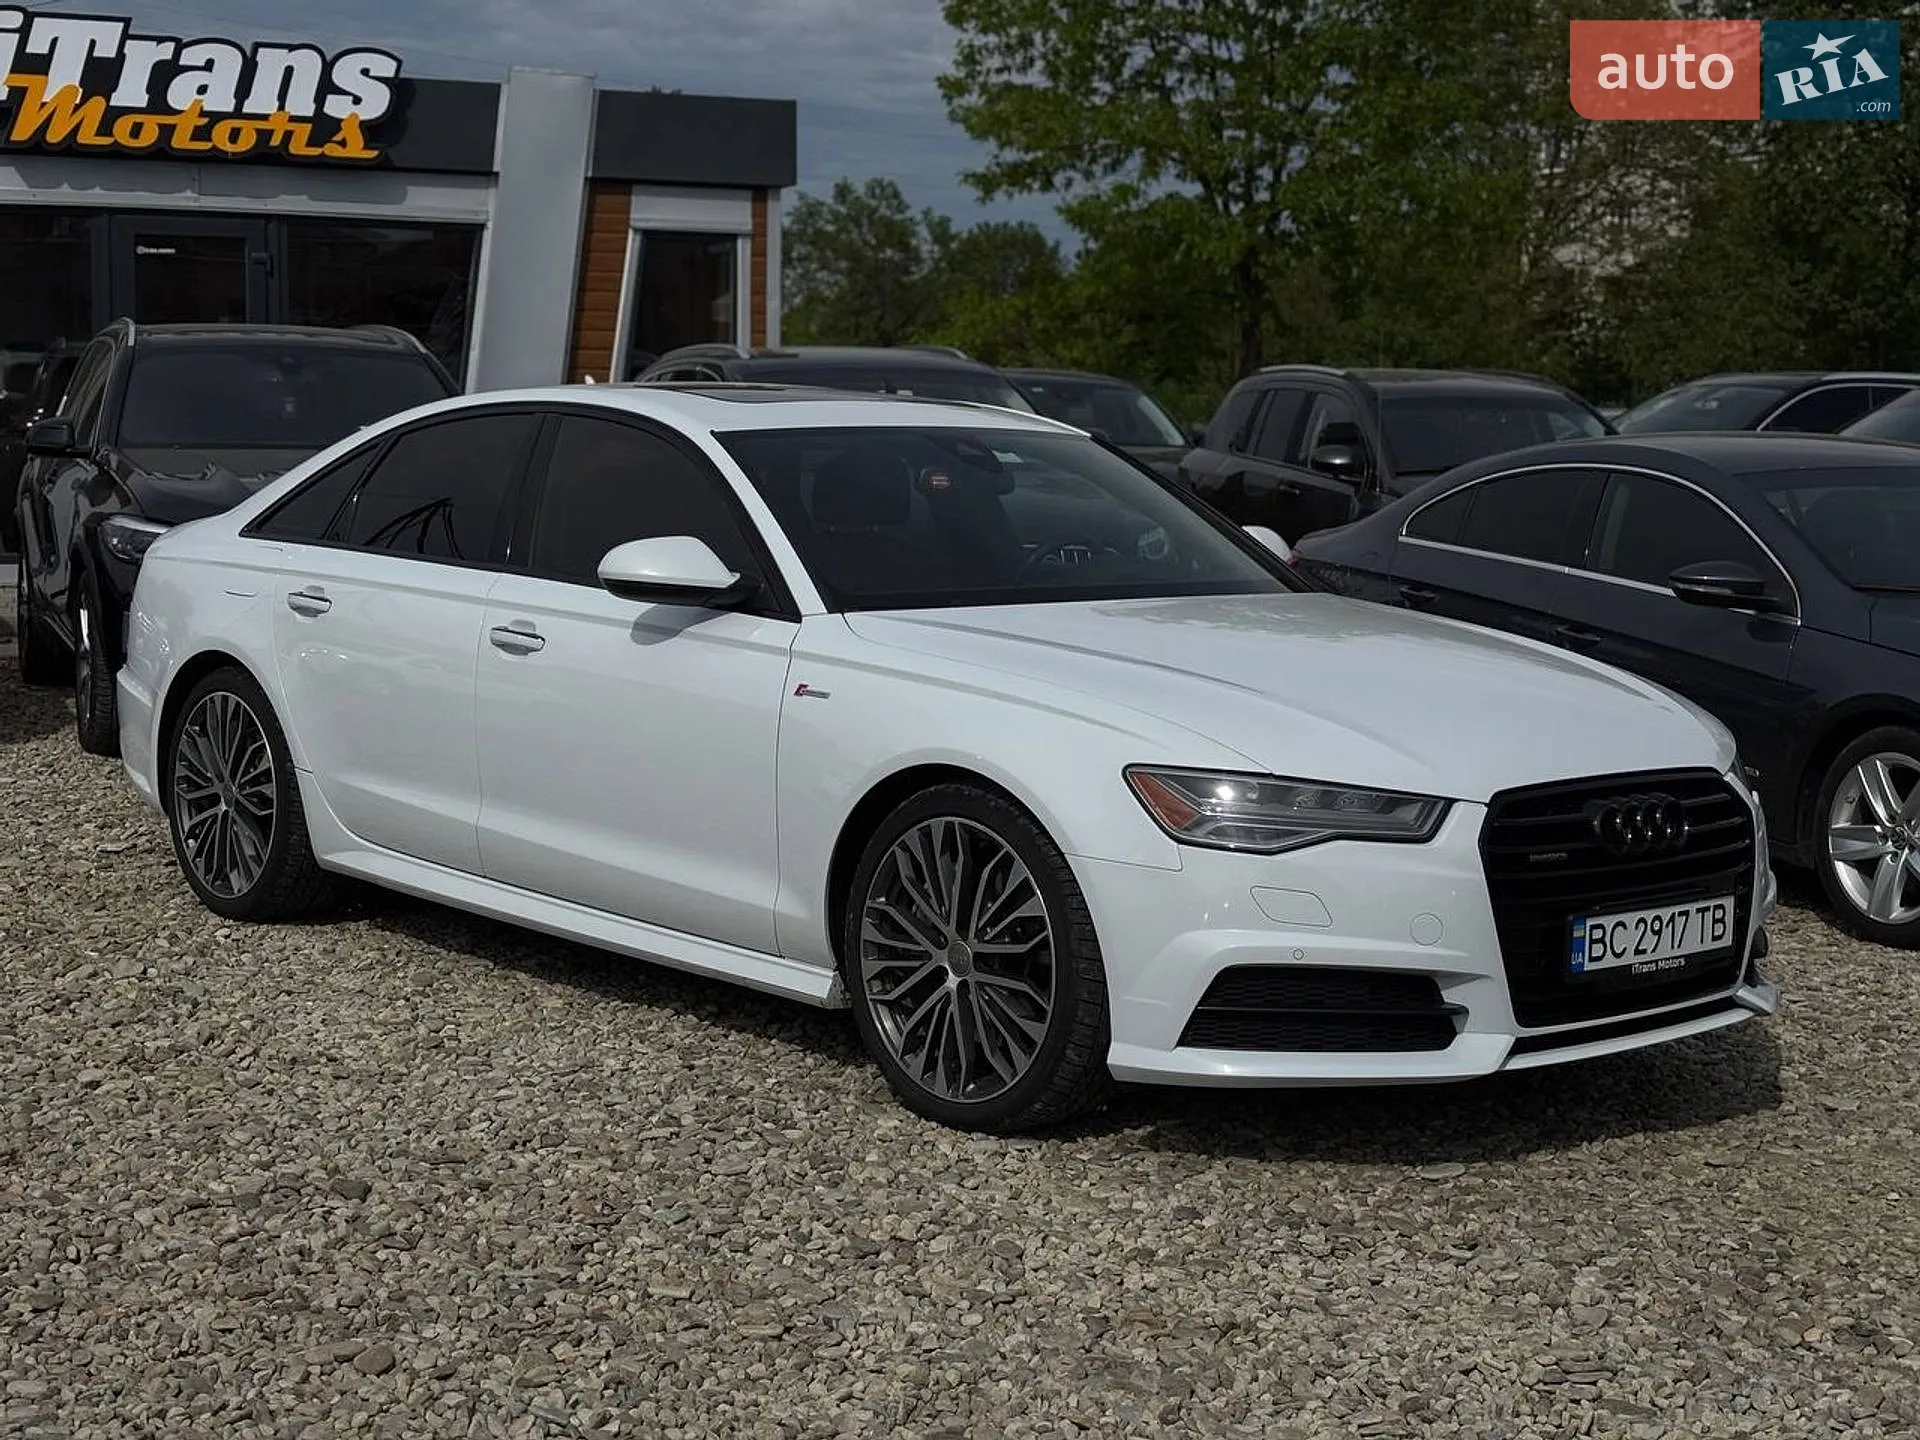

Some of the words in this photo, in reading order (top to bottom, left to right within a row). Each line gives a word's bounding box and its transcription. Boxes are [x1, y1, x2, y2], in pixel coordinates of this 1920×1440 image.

[0, 10, 398, 121] iTrans
[6, 73, 381, 159] Motors
[1571, 951, 1584, 965] UA
[1588, 921, 1628, 963] BC
[1633, 909, 1690, 956] 2917
[1695, 903, 1727, 945] TB
